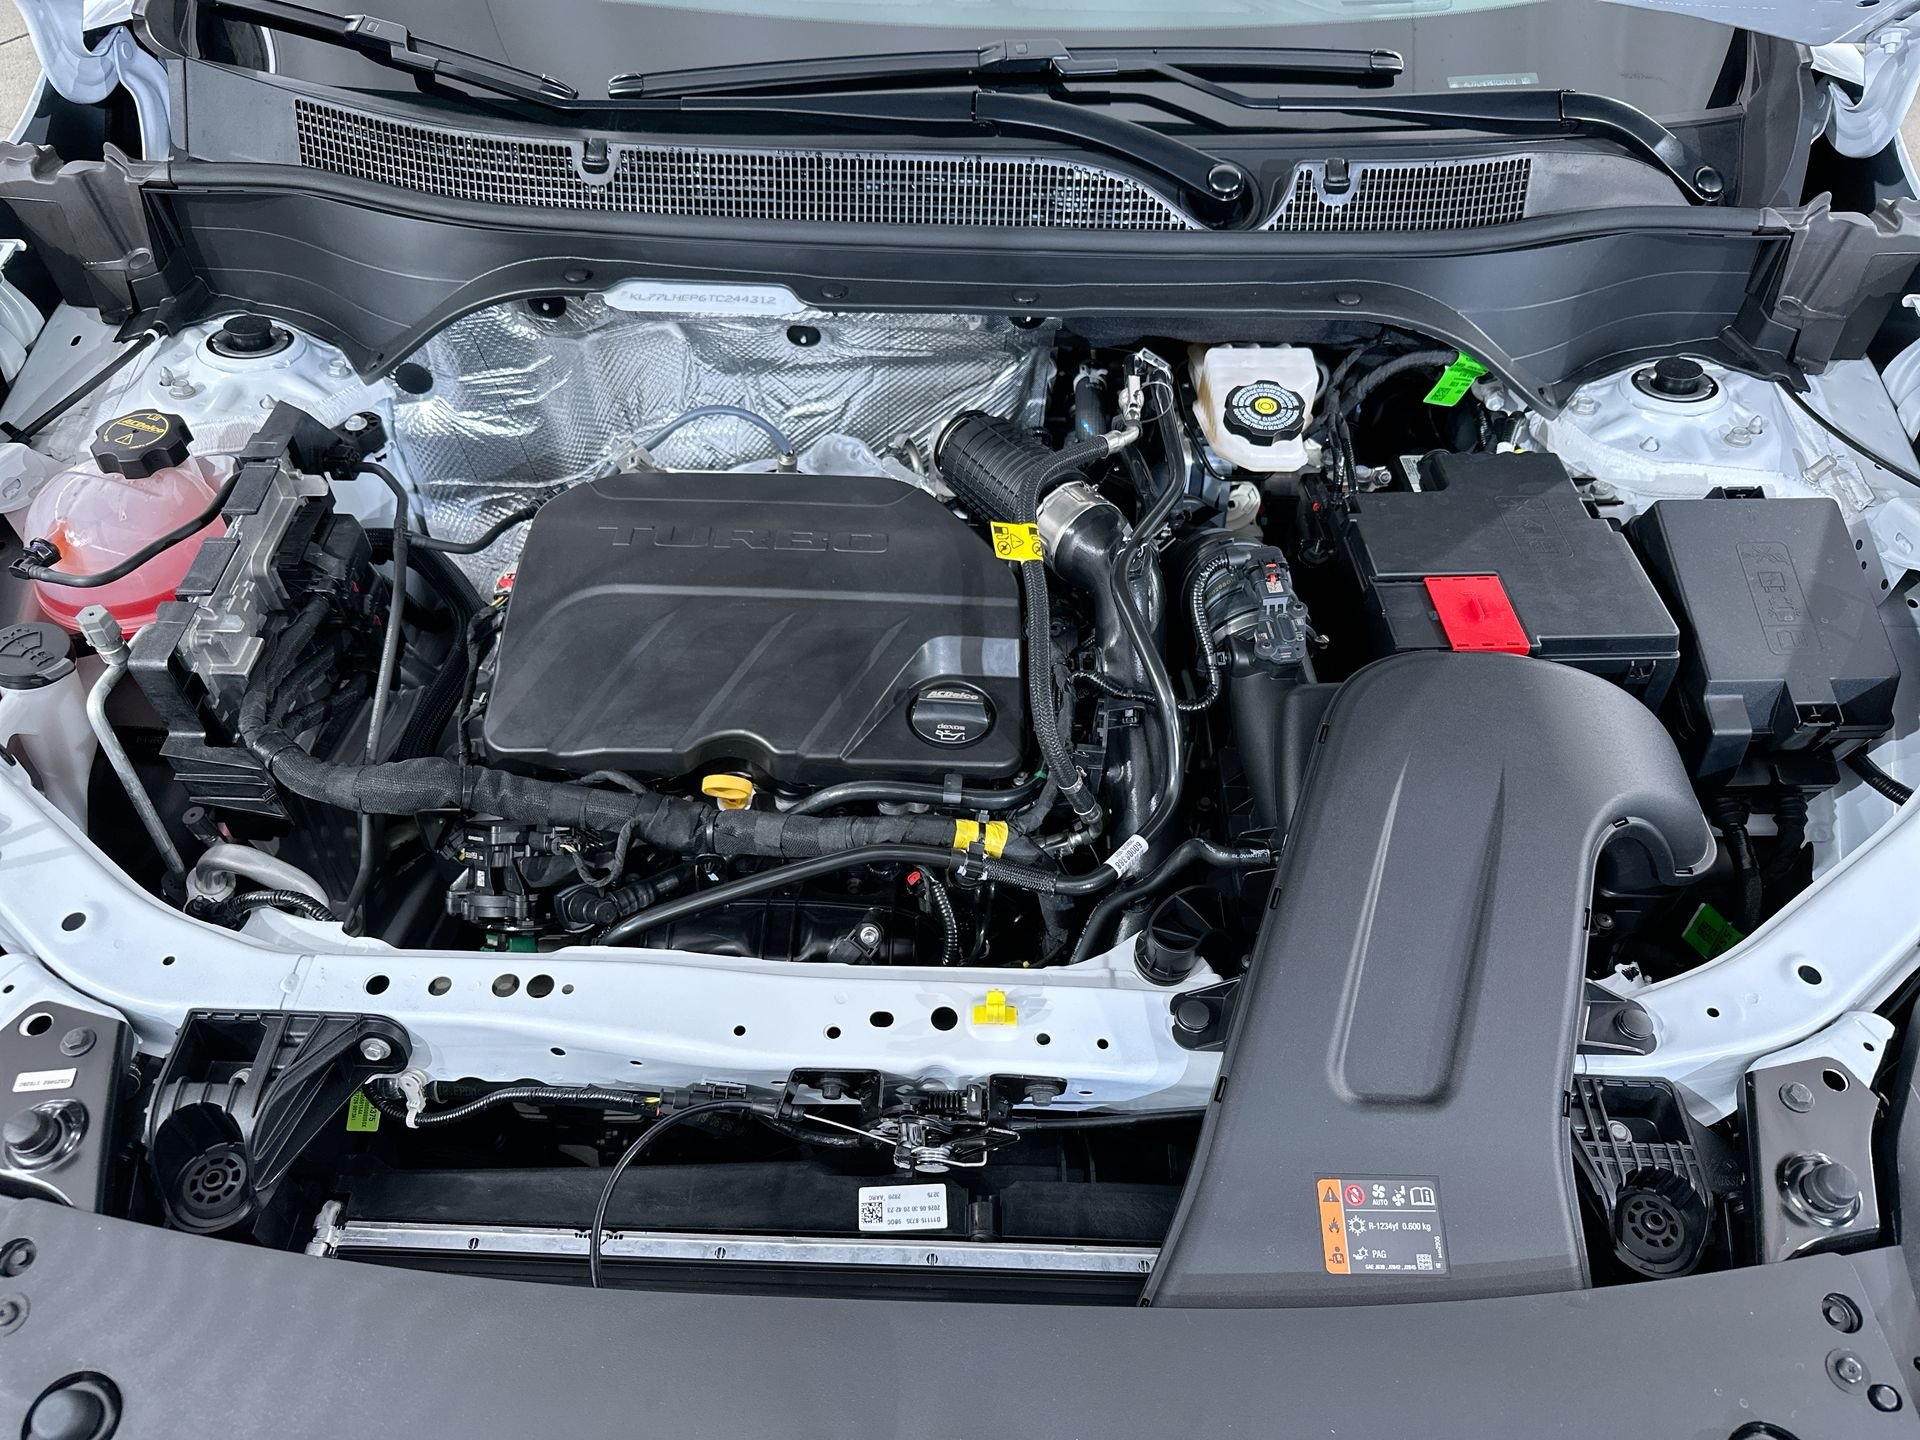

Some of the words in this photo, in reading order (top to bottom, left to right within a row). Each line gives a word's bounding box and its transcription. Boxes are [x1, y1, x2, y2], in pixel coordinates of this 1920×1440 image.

[120, 419, 165, 433] ACDelco
[598, 526, 889, 553] TURBO
[926, 691, 979, 700] ACDelco
[937, 723, 966, 731] dexos
[1372, 1198, 1388, 1206] AUTO
[1368, 1222, 1399, 1232] R-1234yf
[1402, 1222, 1421, 1231] 0.600
[1422, 1222, 1431, 1232] kg
[1371, 1249, 1387, 1259] PAG
